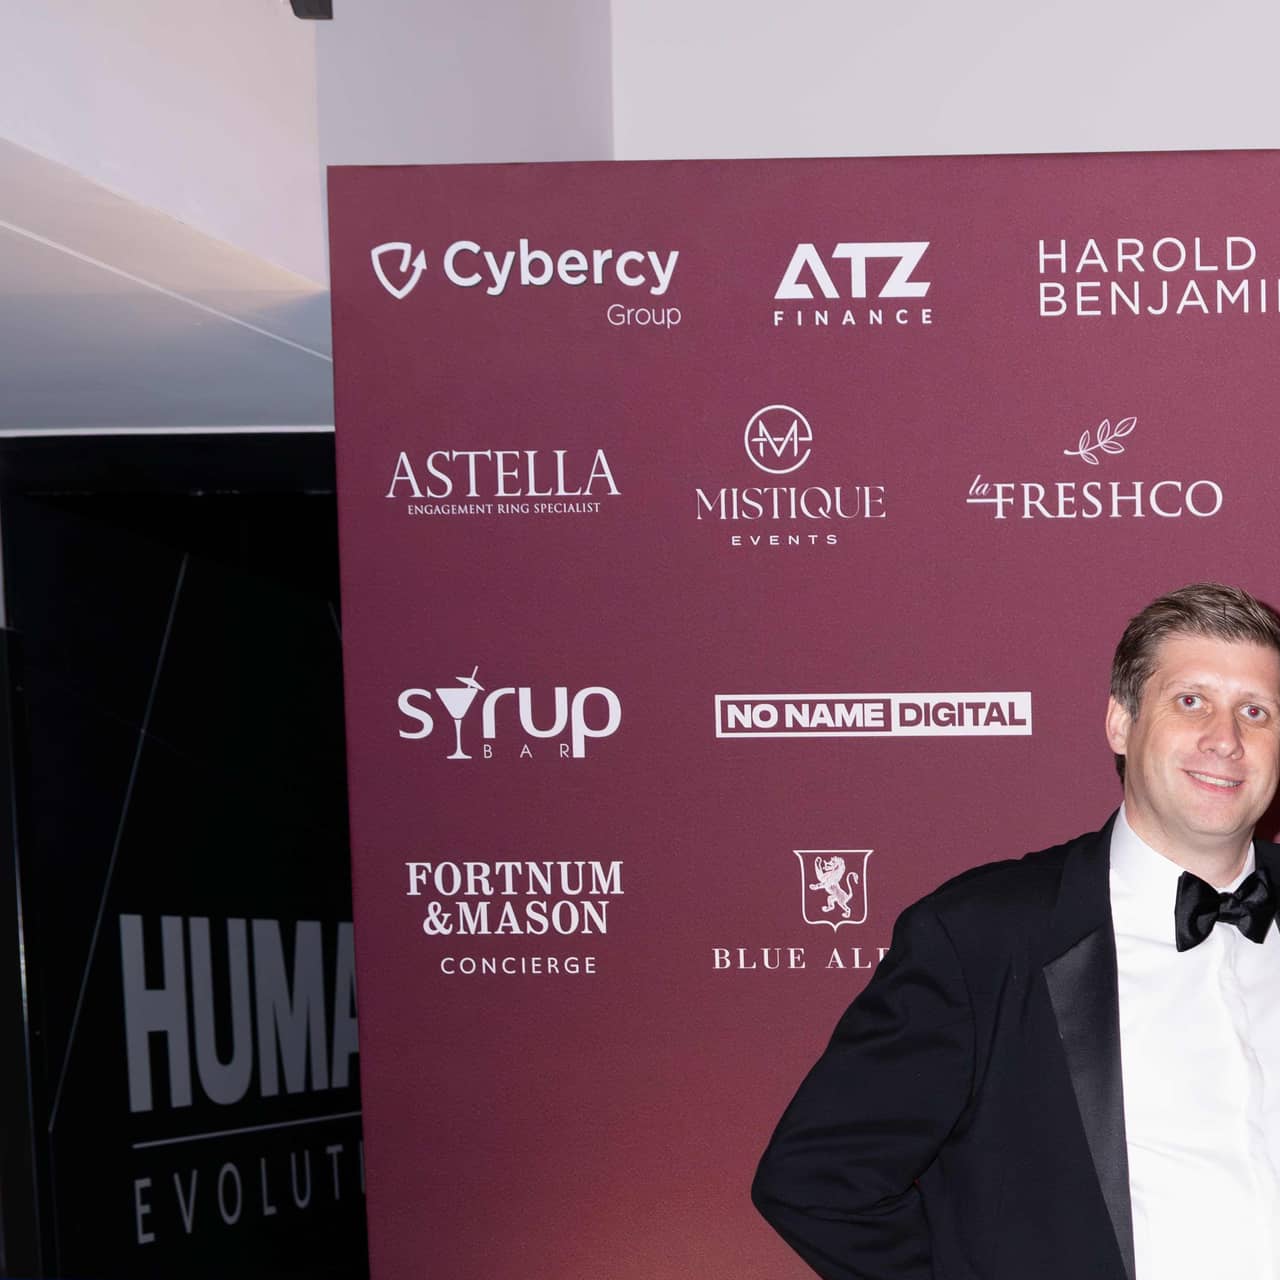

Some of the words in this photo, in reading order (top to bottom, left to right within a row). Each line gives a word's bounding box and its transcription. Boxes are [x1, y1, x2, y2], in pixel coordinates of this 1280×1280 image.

[443, 238, 680, 296] Cybercy
[773, 241, 932, 300] ATZ
[1038, 236, 1257, 274] HAROLD
[606, 303, 682, 329] Group
[773, 308, 933, 327] FINANCE
[385, 448, 622, 499] ASTELLA
[407, 503, 494, 515] ENGAGEMENT
[497, 503, 530, 514] RING
[533, 502, 601, 514] SPECIALIST
[695, 485, 886, 520] MISTIQUE
[993, 479, 1223, 519] FRESHCO
[731, 534, 838, 546] EVENTS
[725, 702, 779, 729] NO
[784, 702, 885, 729] NAME
[898, 701, 1028, 727] DIGITAL
[483, 743, 570, 759] BAR
[405, 860, 625, 896] FORTNUM
[422, 900, 610, 936] &MASON
[440, 956, 596, 975] CONCIERGE
[711, 947, 806, 970] BLUE
